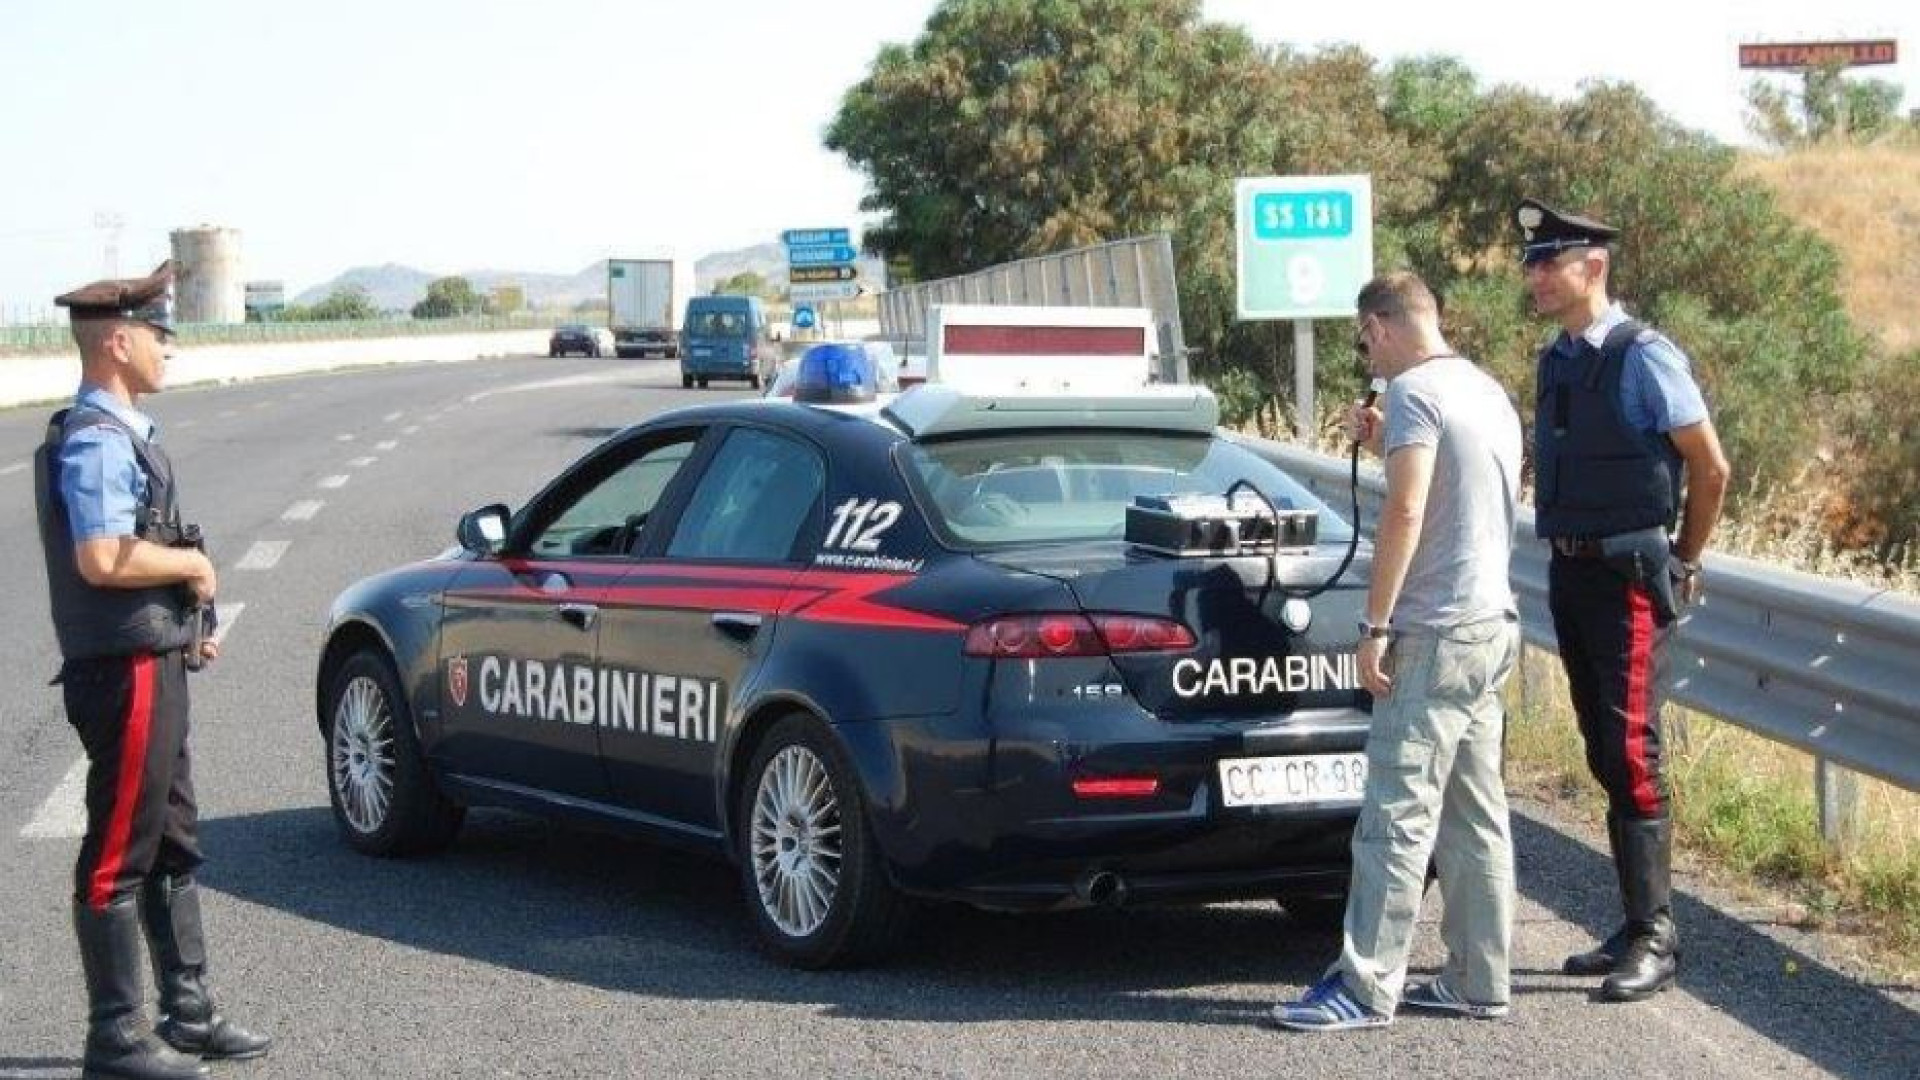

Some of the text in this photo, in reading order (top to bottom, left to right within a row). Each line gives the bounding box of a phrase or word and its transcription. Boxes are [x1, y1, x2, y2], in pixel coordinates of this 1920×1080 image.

[1263, 200, 1343, 229] SS 131
[822, 497, 903, 551] 112
[479, 655, 718, 743] CARABINIERI
[1227, 763, 1265, 799] CC
